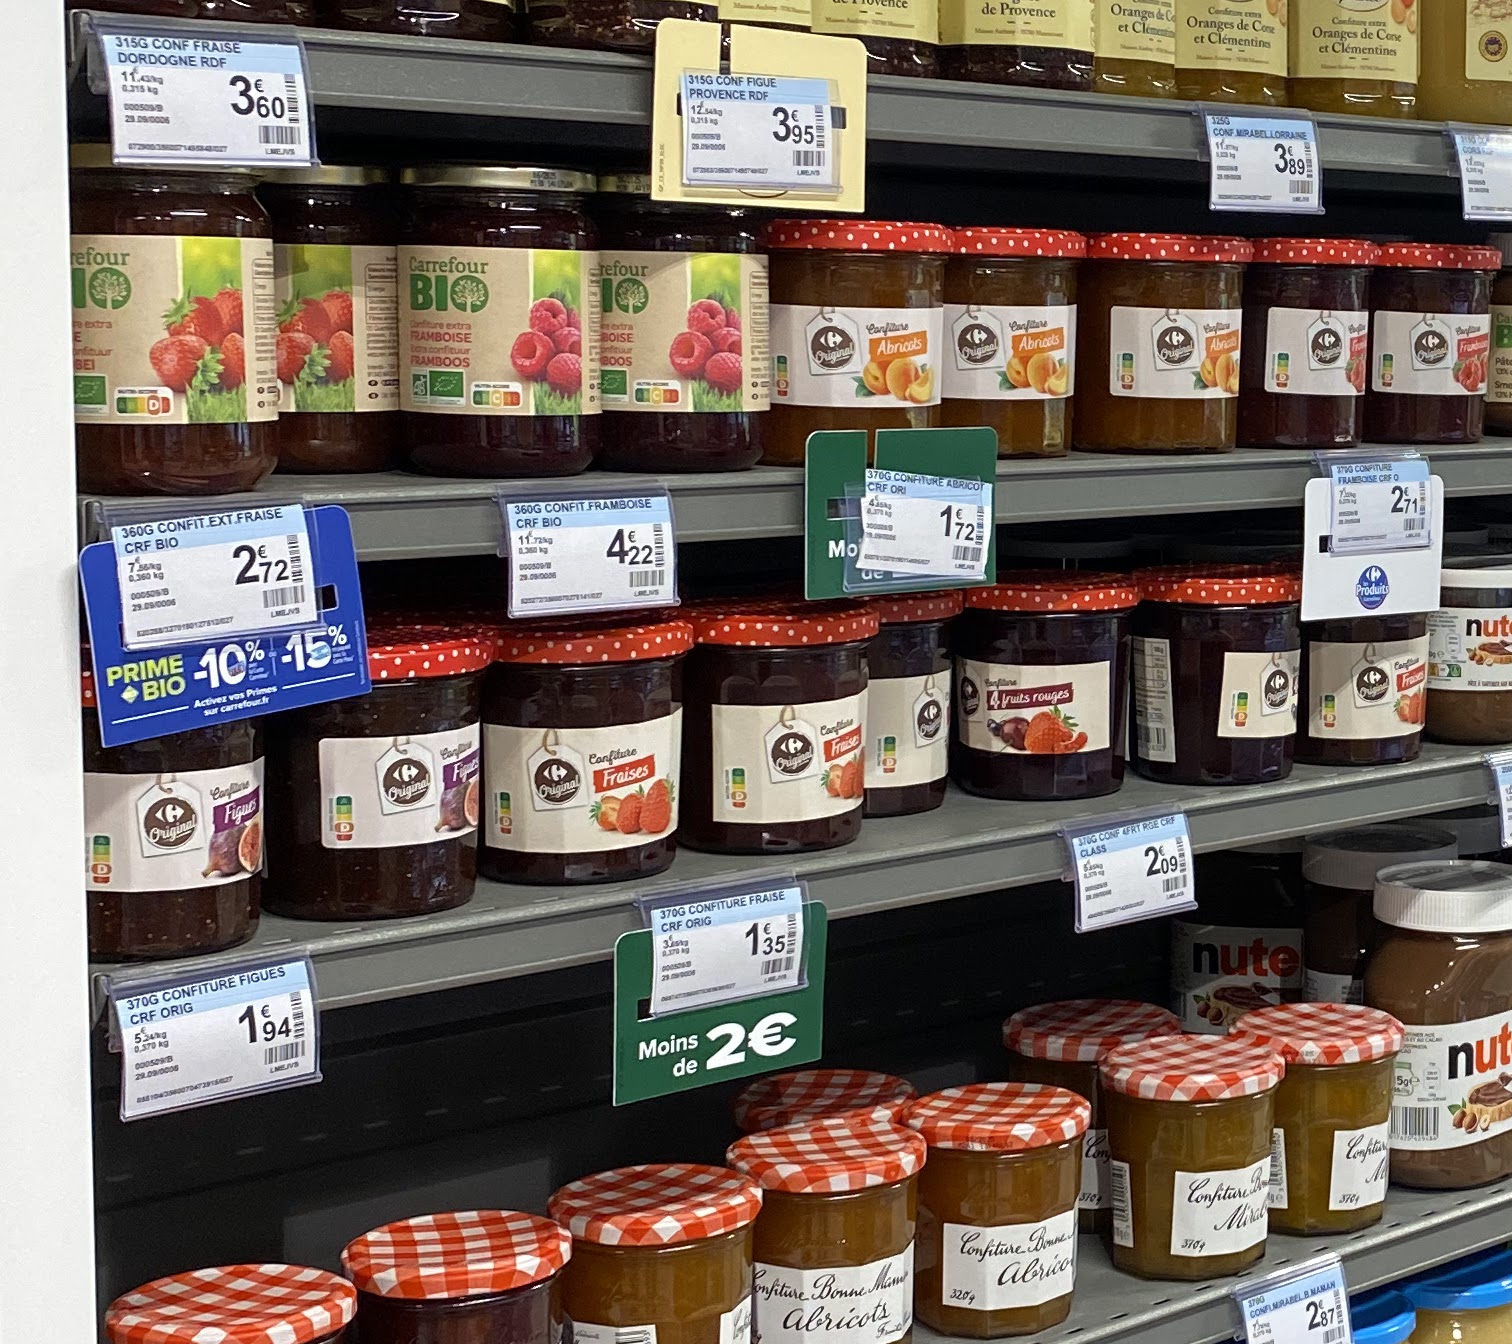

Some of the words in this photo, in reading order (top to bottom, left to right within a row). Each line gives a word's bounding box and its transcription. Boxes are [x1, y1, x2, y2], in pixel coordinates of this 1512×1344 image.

[116, 37, 149, 51] 315G
[153, 38, 190, 53] CONF
[194, 40, 241, 55] FRAISE
[1328, 42, 1397, 58] Clémentines
[118, 53, 196, 67] DORDOGNE
[200, 55, 227, 70] RDF
[746, 77, 777, 89] FIGUE
[689, 88, 745, 101] PROVENCE
[748, 90, 769, 102] RDF
[409, 256, 489, 275] Carrefour
[409, 274, 489, 313] BIO
[410, 331, 472, 343] FRAMBOISE
[877, 335, 922, 355] Abricots
[894, 472, 944, 487] CONFITURE
[514, 504, 542, 516] 360G
[516, 517, 539, 529] CRF
[542, 516, 562, 528] BIO
[124, 539, 150, 554] CRF
[152, 536, 179, 551] BIO
[1355, 583, 1390, 597] Produits
[106, 654, 184, 688] PRIME
[143, 675, 187, 703] BIO
[1002, 690, 1030, 707] fruits
[1032, 686, 1070, 705] rouges
[193, 694, 230, 711] Activez
[222, 695, 270, 713] carrefour.fr
[603, 763, 649, 788] Fraises
[224, 798, 259, 825] Figues
[148, 815, 199, 844] Original
[660, 907, 686, 920] 370G
[688, 898, 746, 917] CONFITURE
[748, 891, 785, 908] FRAISE
[126, 993, 159, 1010] 370G
[162, 975, 235, 1003] CONFITURE
[238, 966, 286, 986] FIGUES
[130, 1009, 157, 1025] CRF
[160, 1002, 194, 1018] ORIG
[638, 1034, 699, 1060] Moins
[706, 1012, 798, 1070] 2€
[673, 1057, 698, 1077] de
[782, 1300, 889, 1334] Abricots
